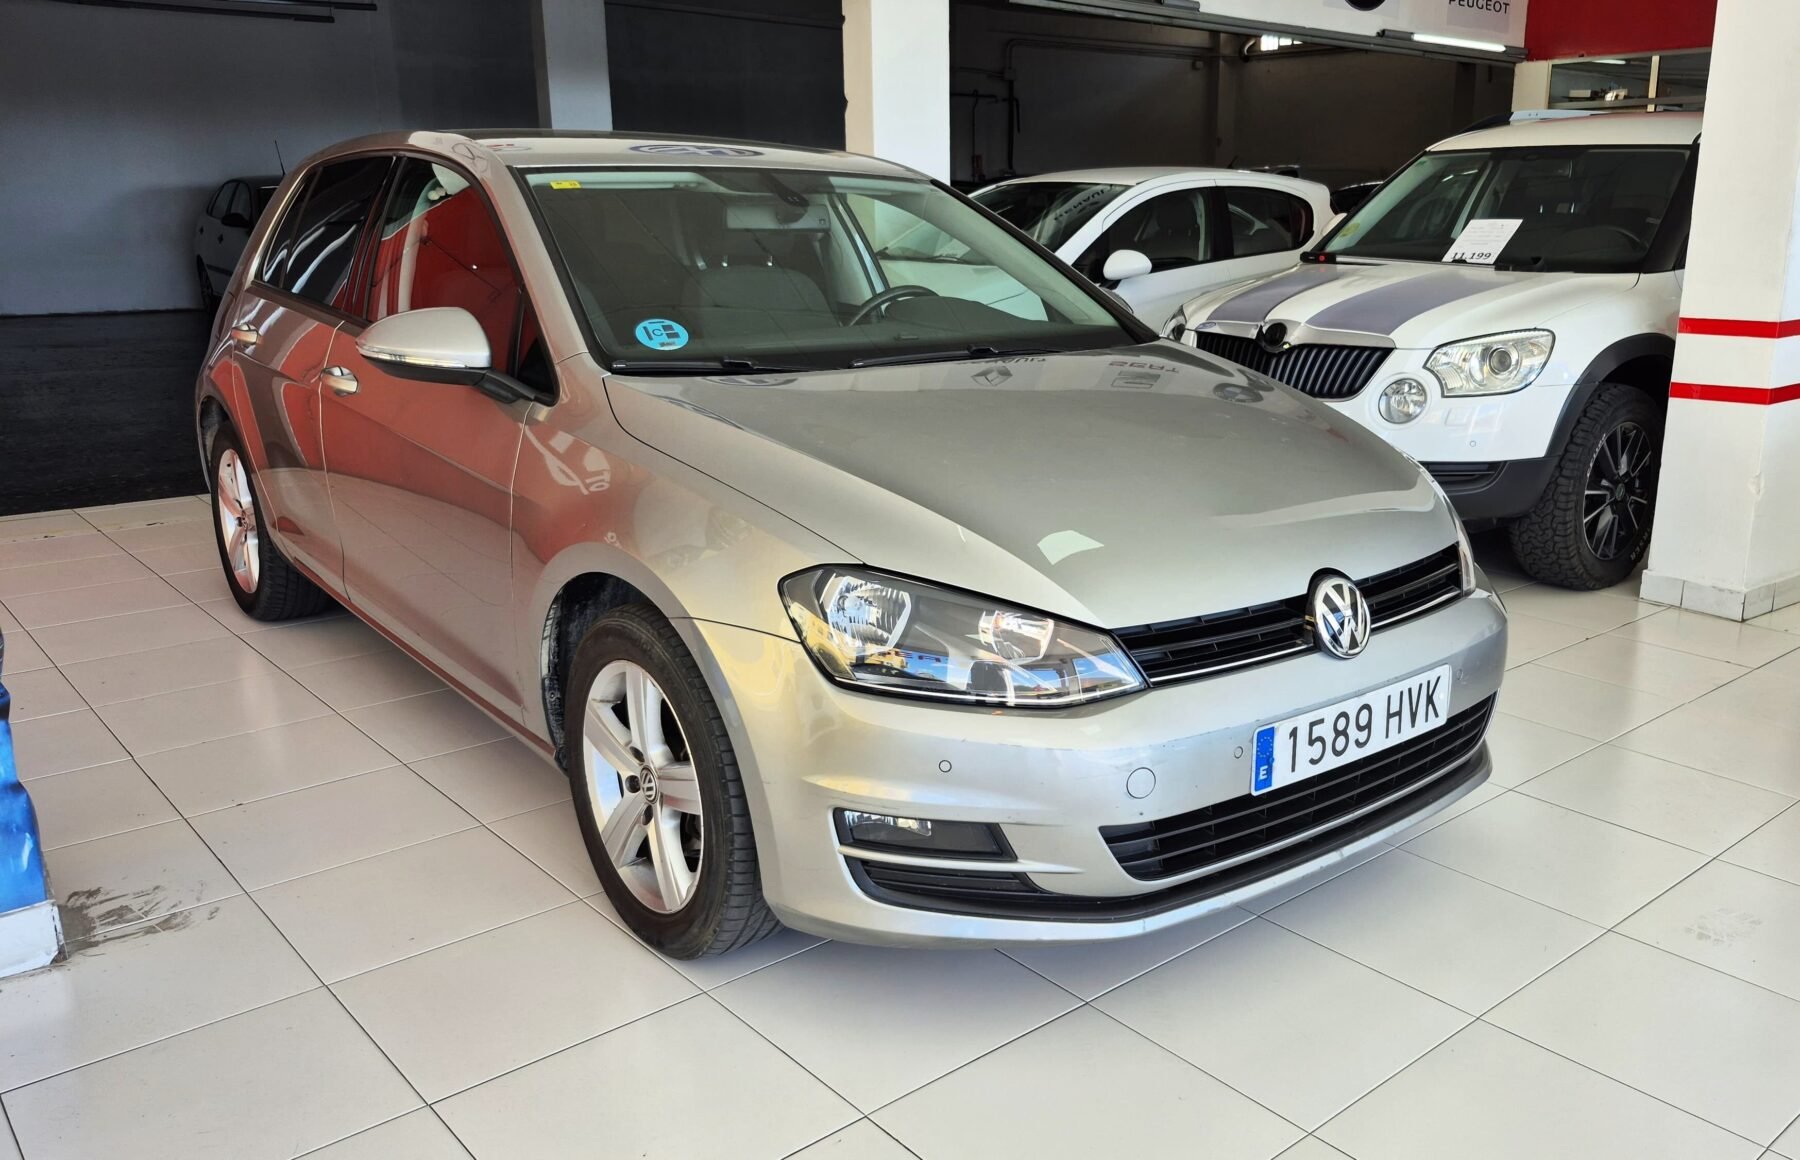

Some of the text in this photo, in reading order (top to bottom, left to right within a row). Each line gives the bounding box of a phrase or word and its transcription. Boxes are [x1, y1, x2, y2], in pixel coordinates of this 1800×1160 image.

[1289, 675, 1441, 773] 1589 HVK
[1259, 765, 1269, 780] E
